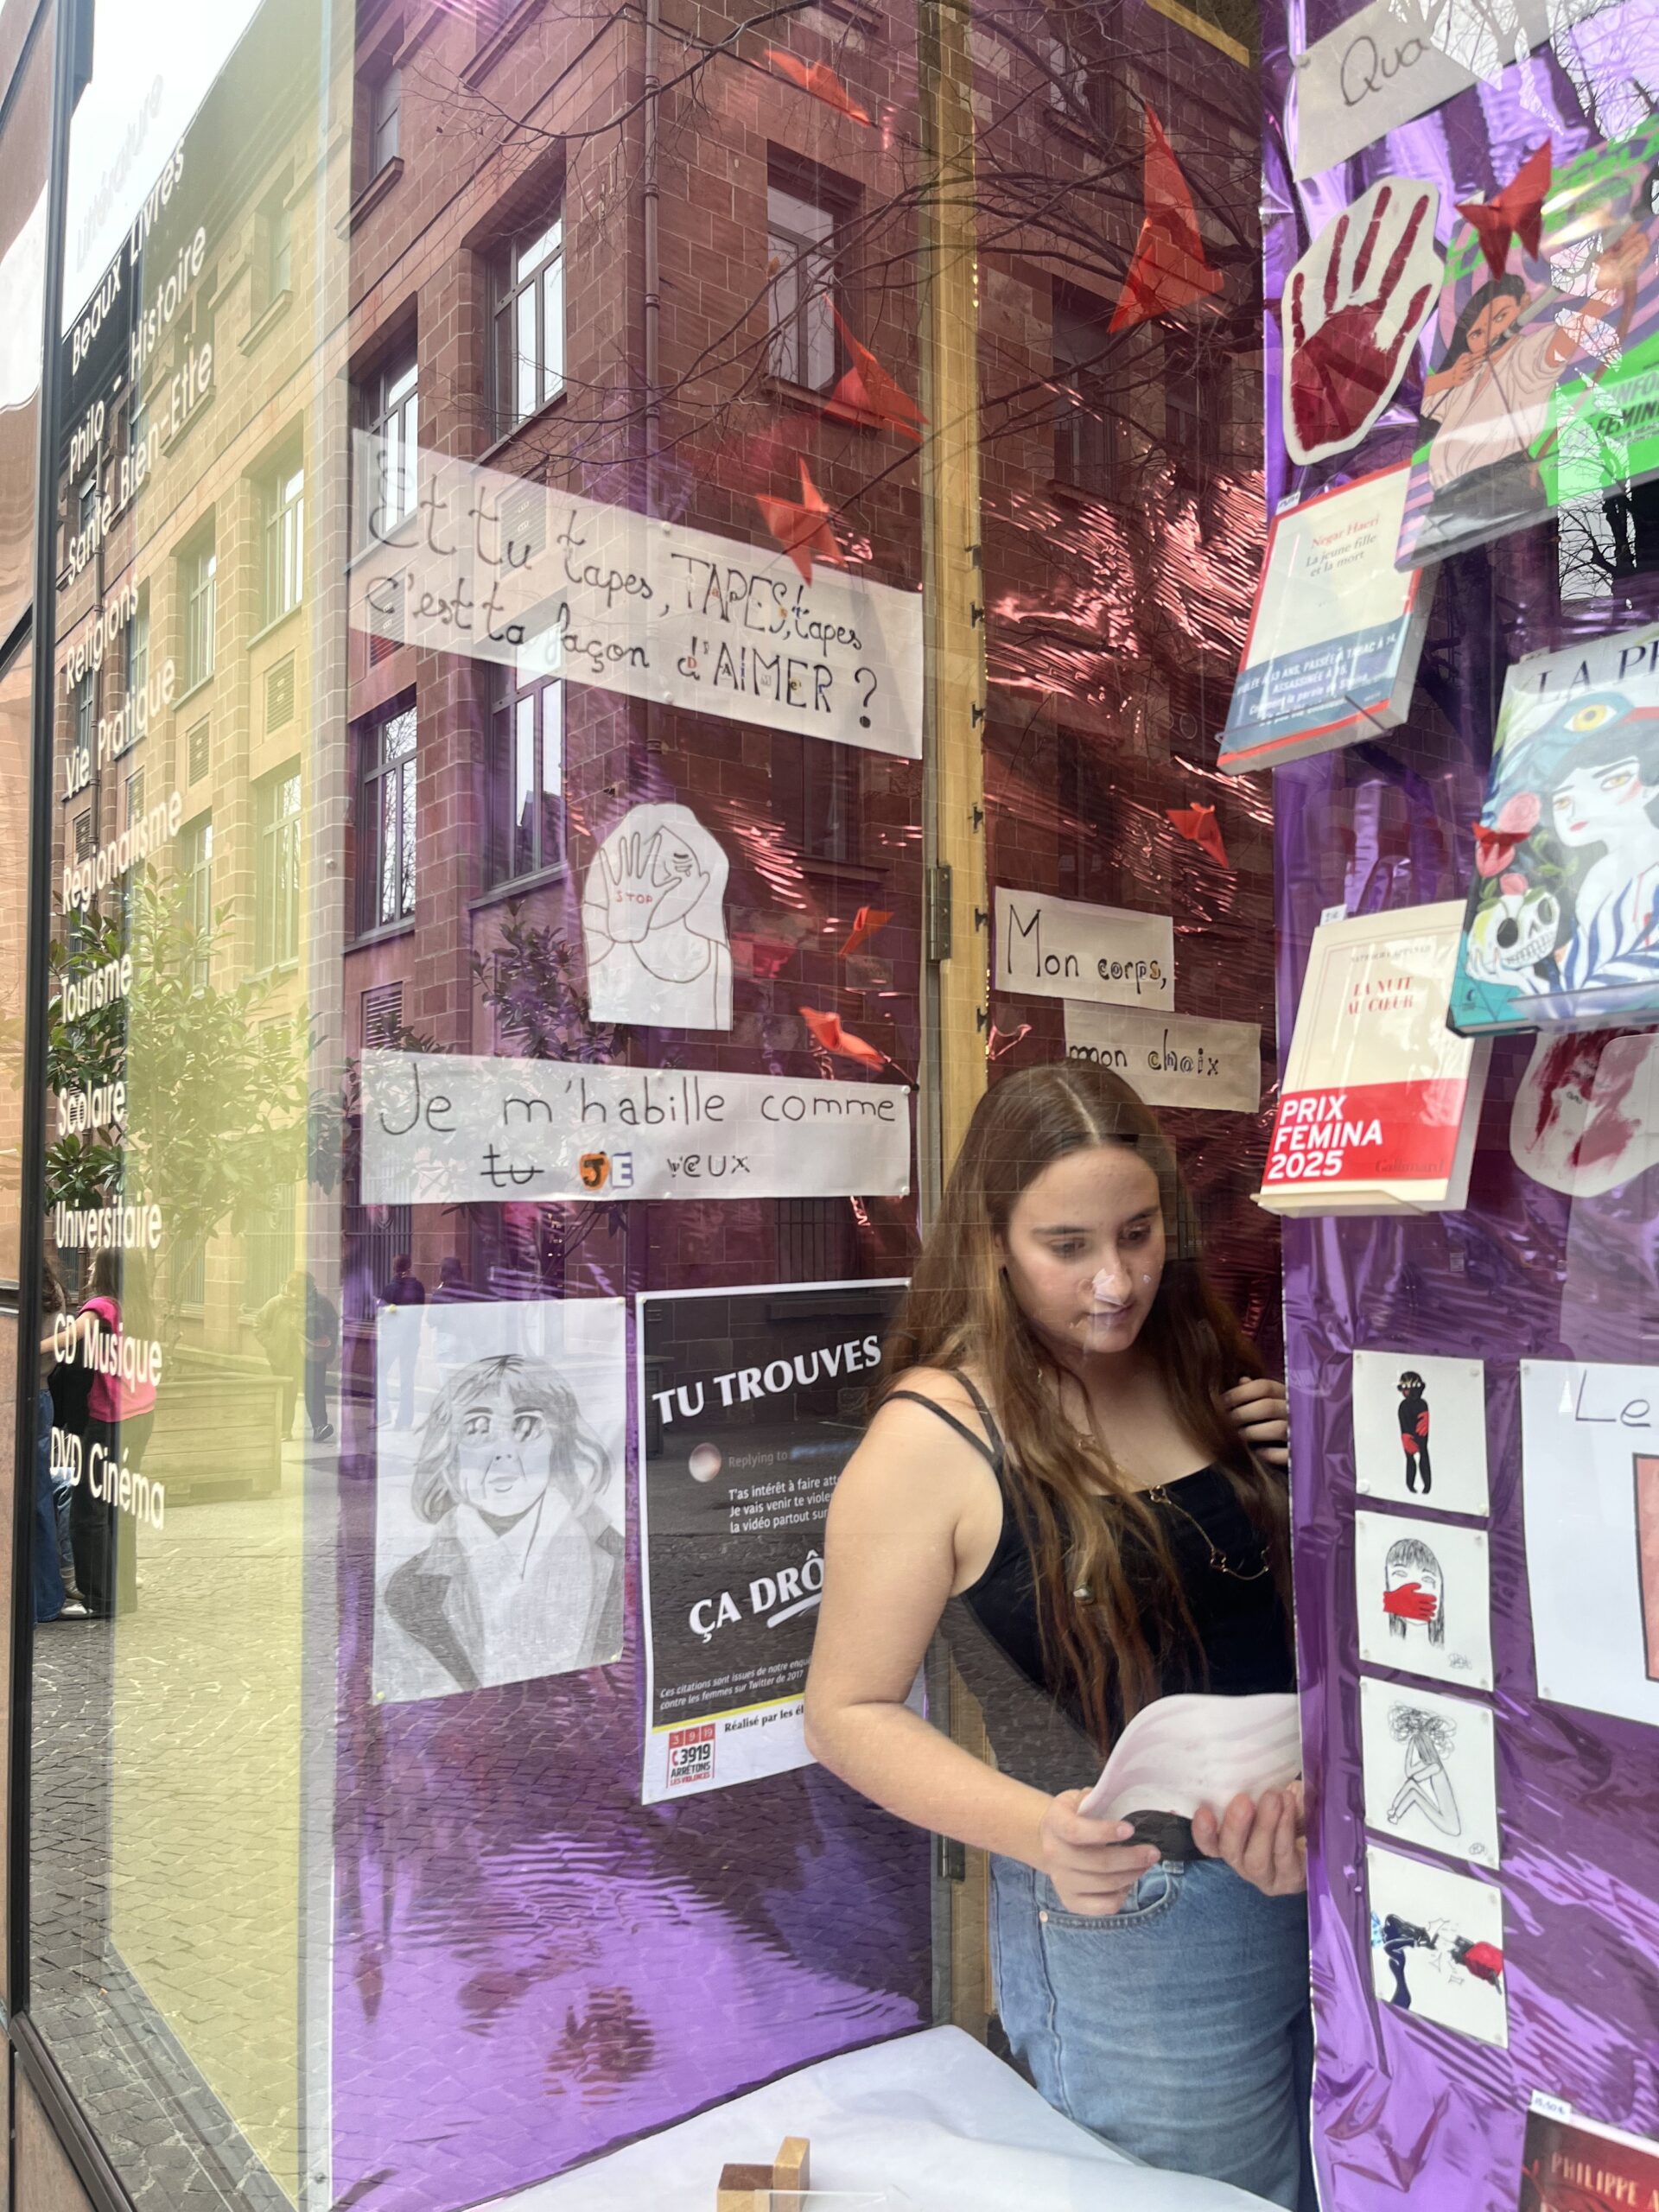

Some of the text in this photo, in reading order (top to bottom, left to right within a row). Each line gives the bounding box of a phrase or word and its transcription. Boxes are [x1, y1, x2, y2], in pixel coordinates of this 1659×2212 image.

[1340, 35, 1431, 105] Qua
[75, 73, 164, 274] Littérature
[72, 137, 186, 376] Beaux Livres
[69, 399, 105, 485] Philo
[130, 226, 207, 382] Histoire
[68, 476, 111, 586] Santé
[369, 450, 458, 556] Et
[468, 486, 532, 570] tu
[791, 585, 862, 657] tapes
[1319, 543, 1351, 564] jeune
[1354, 533, 1378, 550] fille
[1310, 550, 1365, 577] et la mort
[66, 569, 139, 695] Religions
[365, 572, 878, 728] C'est ta façon d'AIMER ?
[1537, 659, 1592, 704] LA
[66, 658, 175, 799] Vie Pratique
[62, 790, 182, 914] Régionalisme
[615, 890, 653, 906] STOP
[1007, 903, 1167, 995] Mon corps,
[61, 953, 133, 1023] Tourisme
[1147, 1028, 1219, 1077] choix
[58, 1074, 127, 1135] Scolaire
[379, 1064, 897, 1135] Je m'habille comme
[1280, 1094, 1347, 1125] PRIX
[1274, 1119, 1382, 1153] FEMINA
[480, 1144, 750, 1191] tu JE veux
[1268, 1150, 1344, 1179] 2025
[56, 1194, 162, 1249] Universitaire
[53, 1313, 163, 1392] CD Musique
[652, 1335, 882, 1425] TU TROUVES
[1575, 1370, 1651, 1427] Le
[50, 1426, 166, 1529] DVD Cinéma
[728, 1451, 788, 1469] Replying to
[728, 1475, 838, 1502] T'as intérêt à faire att
[728, 1505, 741, 1518] Je
[743, 1503, 764, 1516] vais
[766, 1497, 791, 1511] venir
[794, 1495, 804, 1507] te
[730, 1510, 828, 1534] la vidéo partout sur
[689, 1549, 825, 1643] ÇA DRÔ
[660, 1657, 811, 1699] Ces citations sont issues de notre enqu
[660, 1669, 804, 1711] contre les femmes sur Twitter de 2017
[724, 1705, 804, 1732] Réalisé par les él
[680, 1743, 711, 1765] 3919
[1551, 2152, 1639, 2207] PHILIPPE
